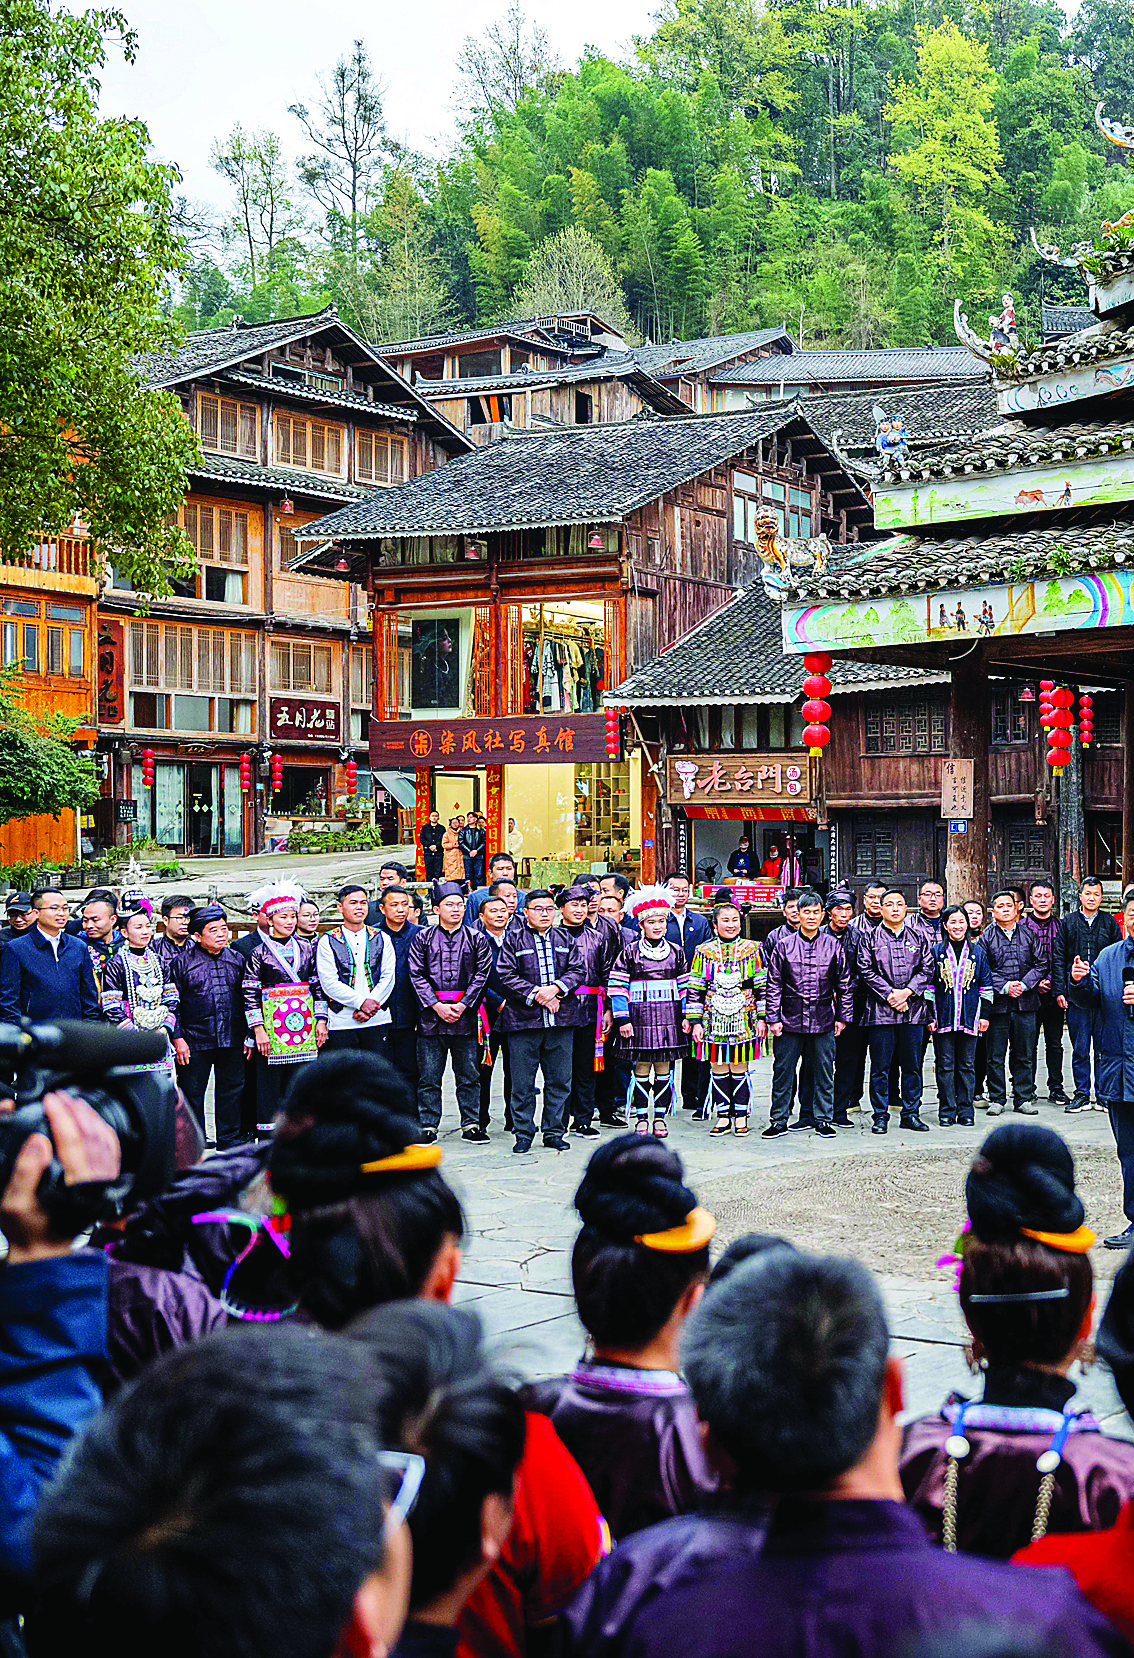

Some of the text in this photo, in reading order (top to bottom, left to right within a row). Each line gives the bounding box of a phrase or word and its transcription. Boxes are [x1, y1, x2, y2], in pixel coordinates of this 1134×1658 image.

[276, 706, 325, 729] 五月花
[438, 725, 577, 755] 柒风社写真馆
